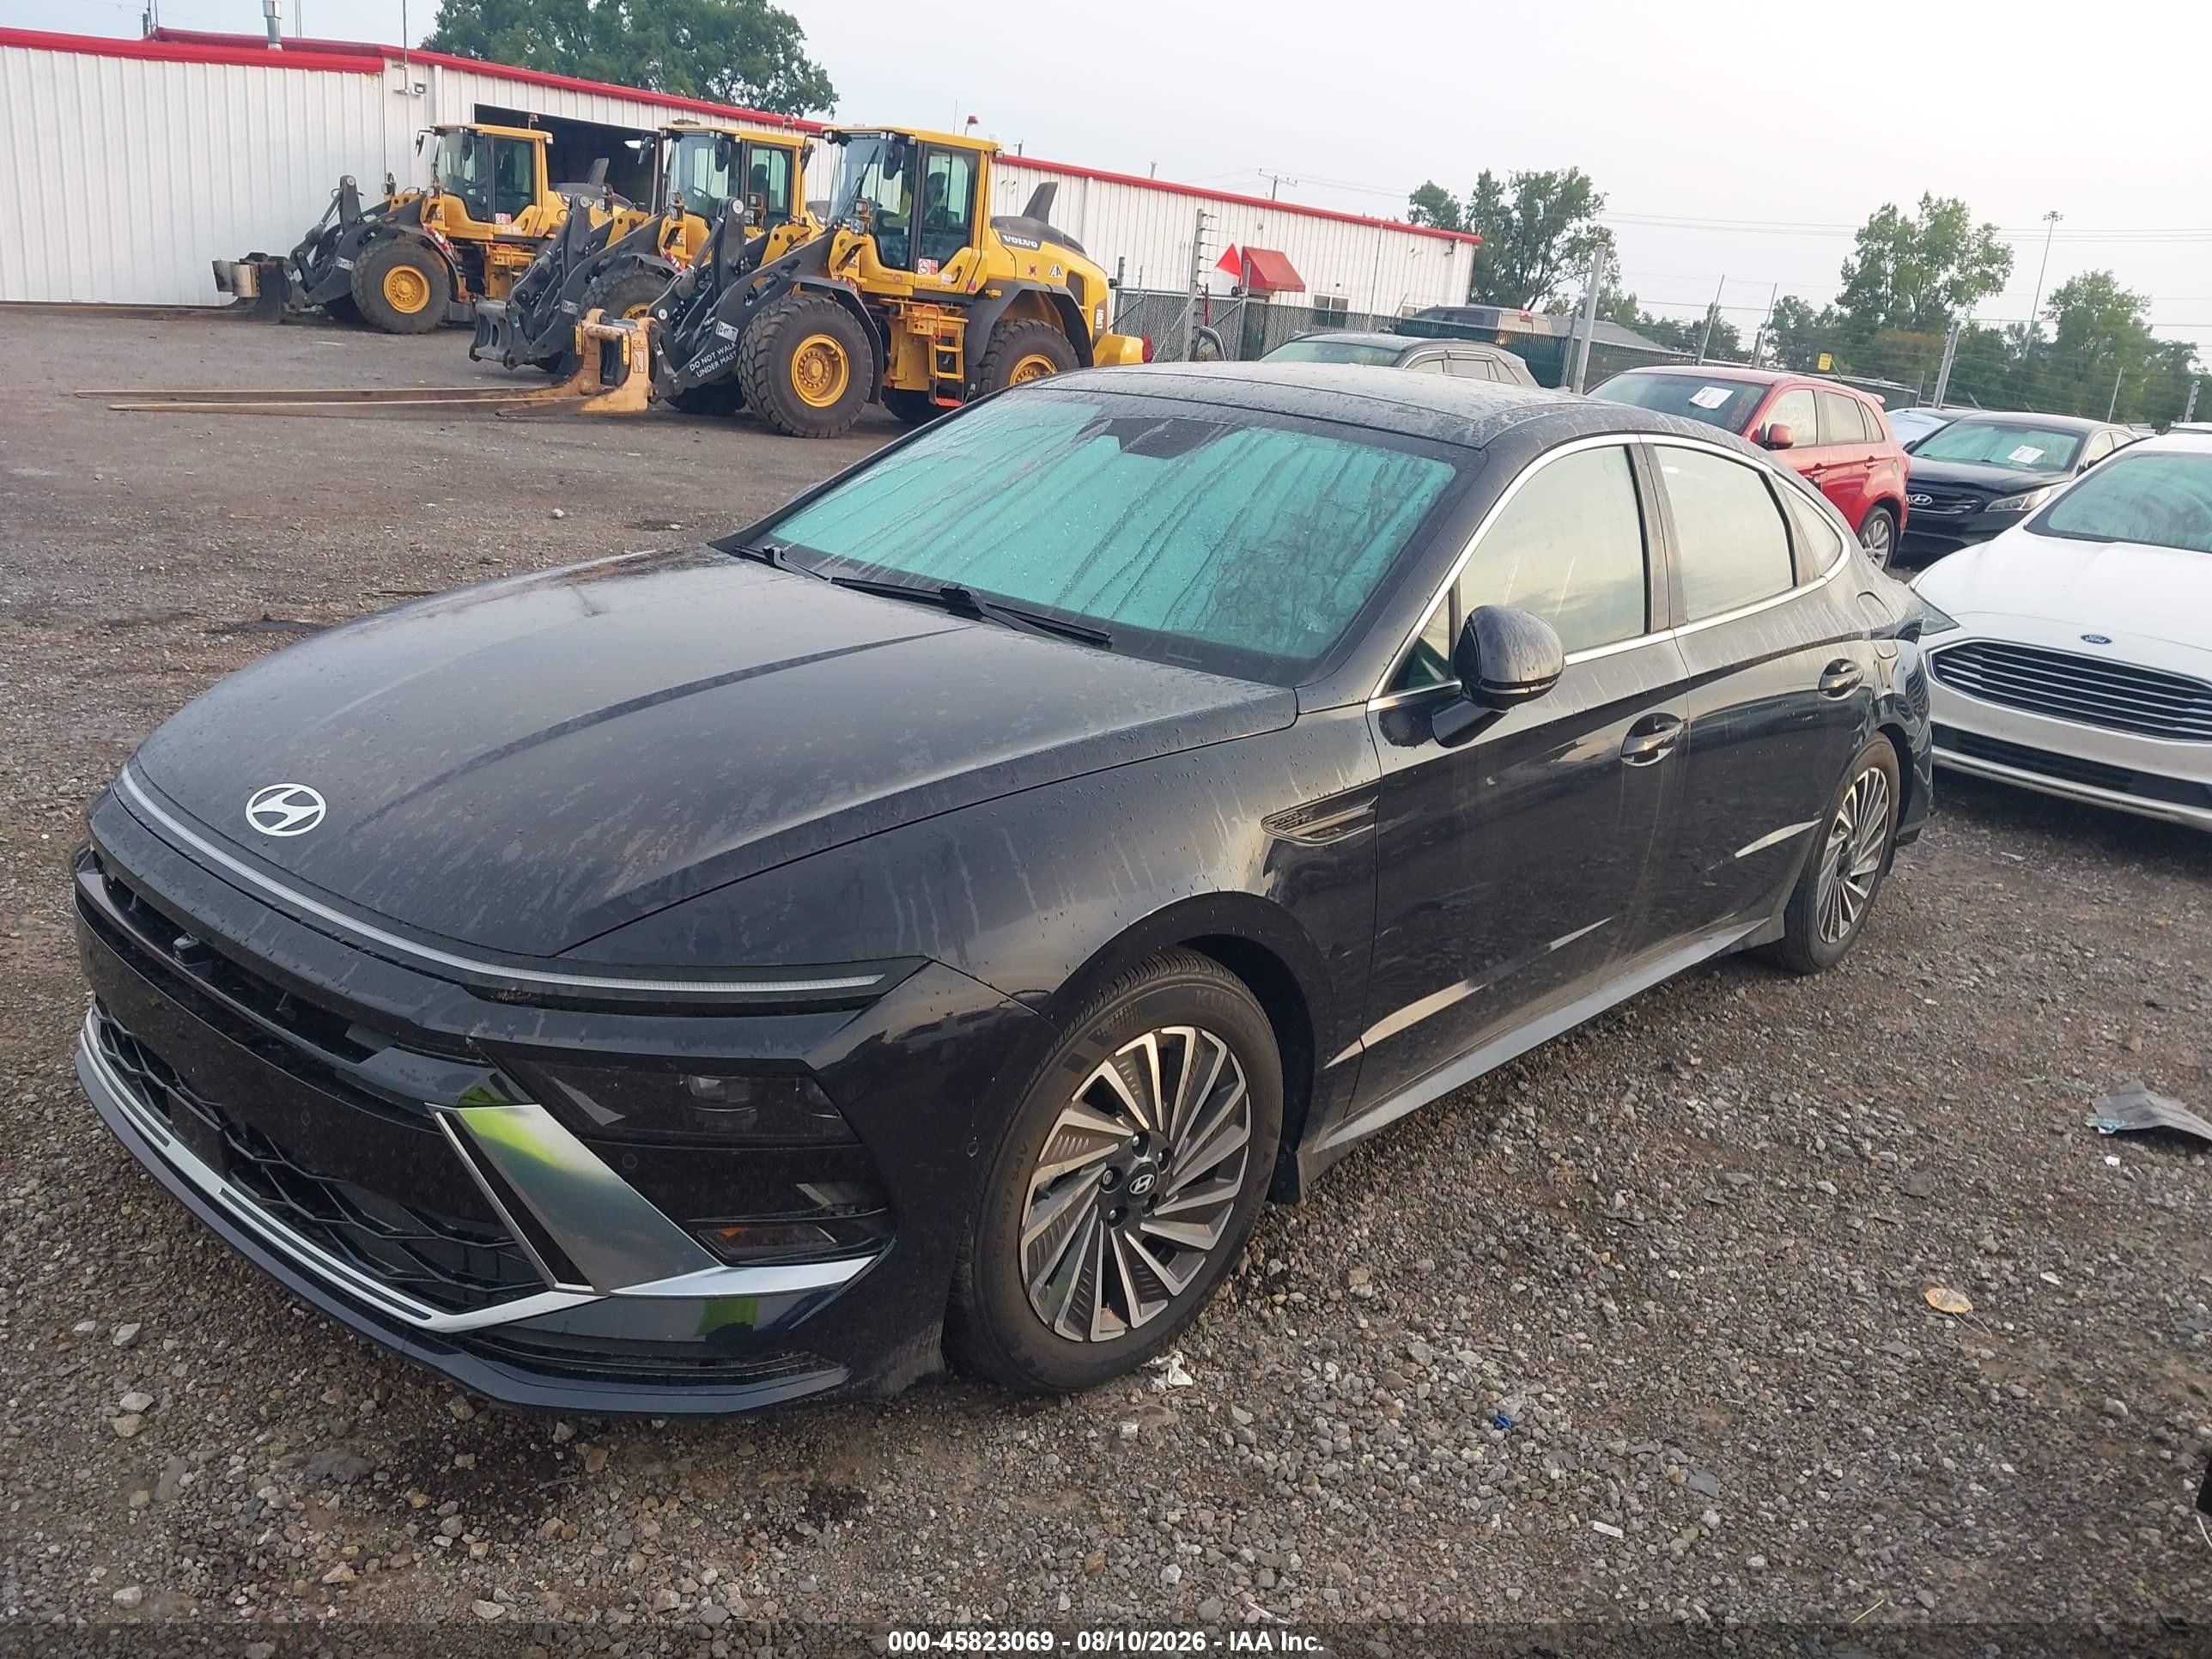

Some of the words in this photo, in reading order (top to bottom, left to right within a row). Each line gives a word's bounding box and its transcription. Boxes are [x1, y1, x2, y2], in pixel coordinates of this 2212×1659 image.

[1002, 234, 1038, 248] VOLVO
[690, 361, 701, 372] DO
[701, 351, 716, 365] NOT
[716, 342, 738, 356] WALK
[696, 361, 720, 378] UNDER
[720, 350, 738, 365] MAST
